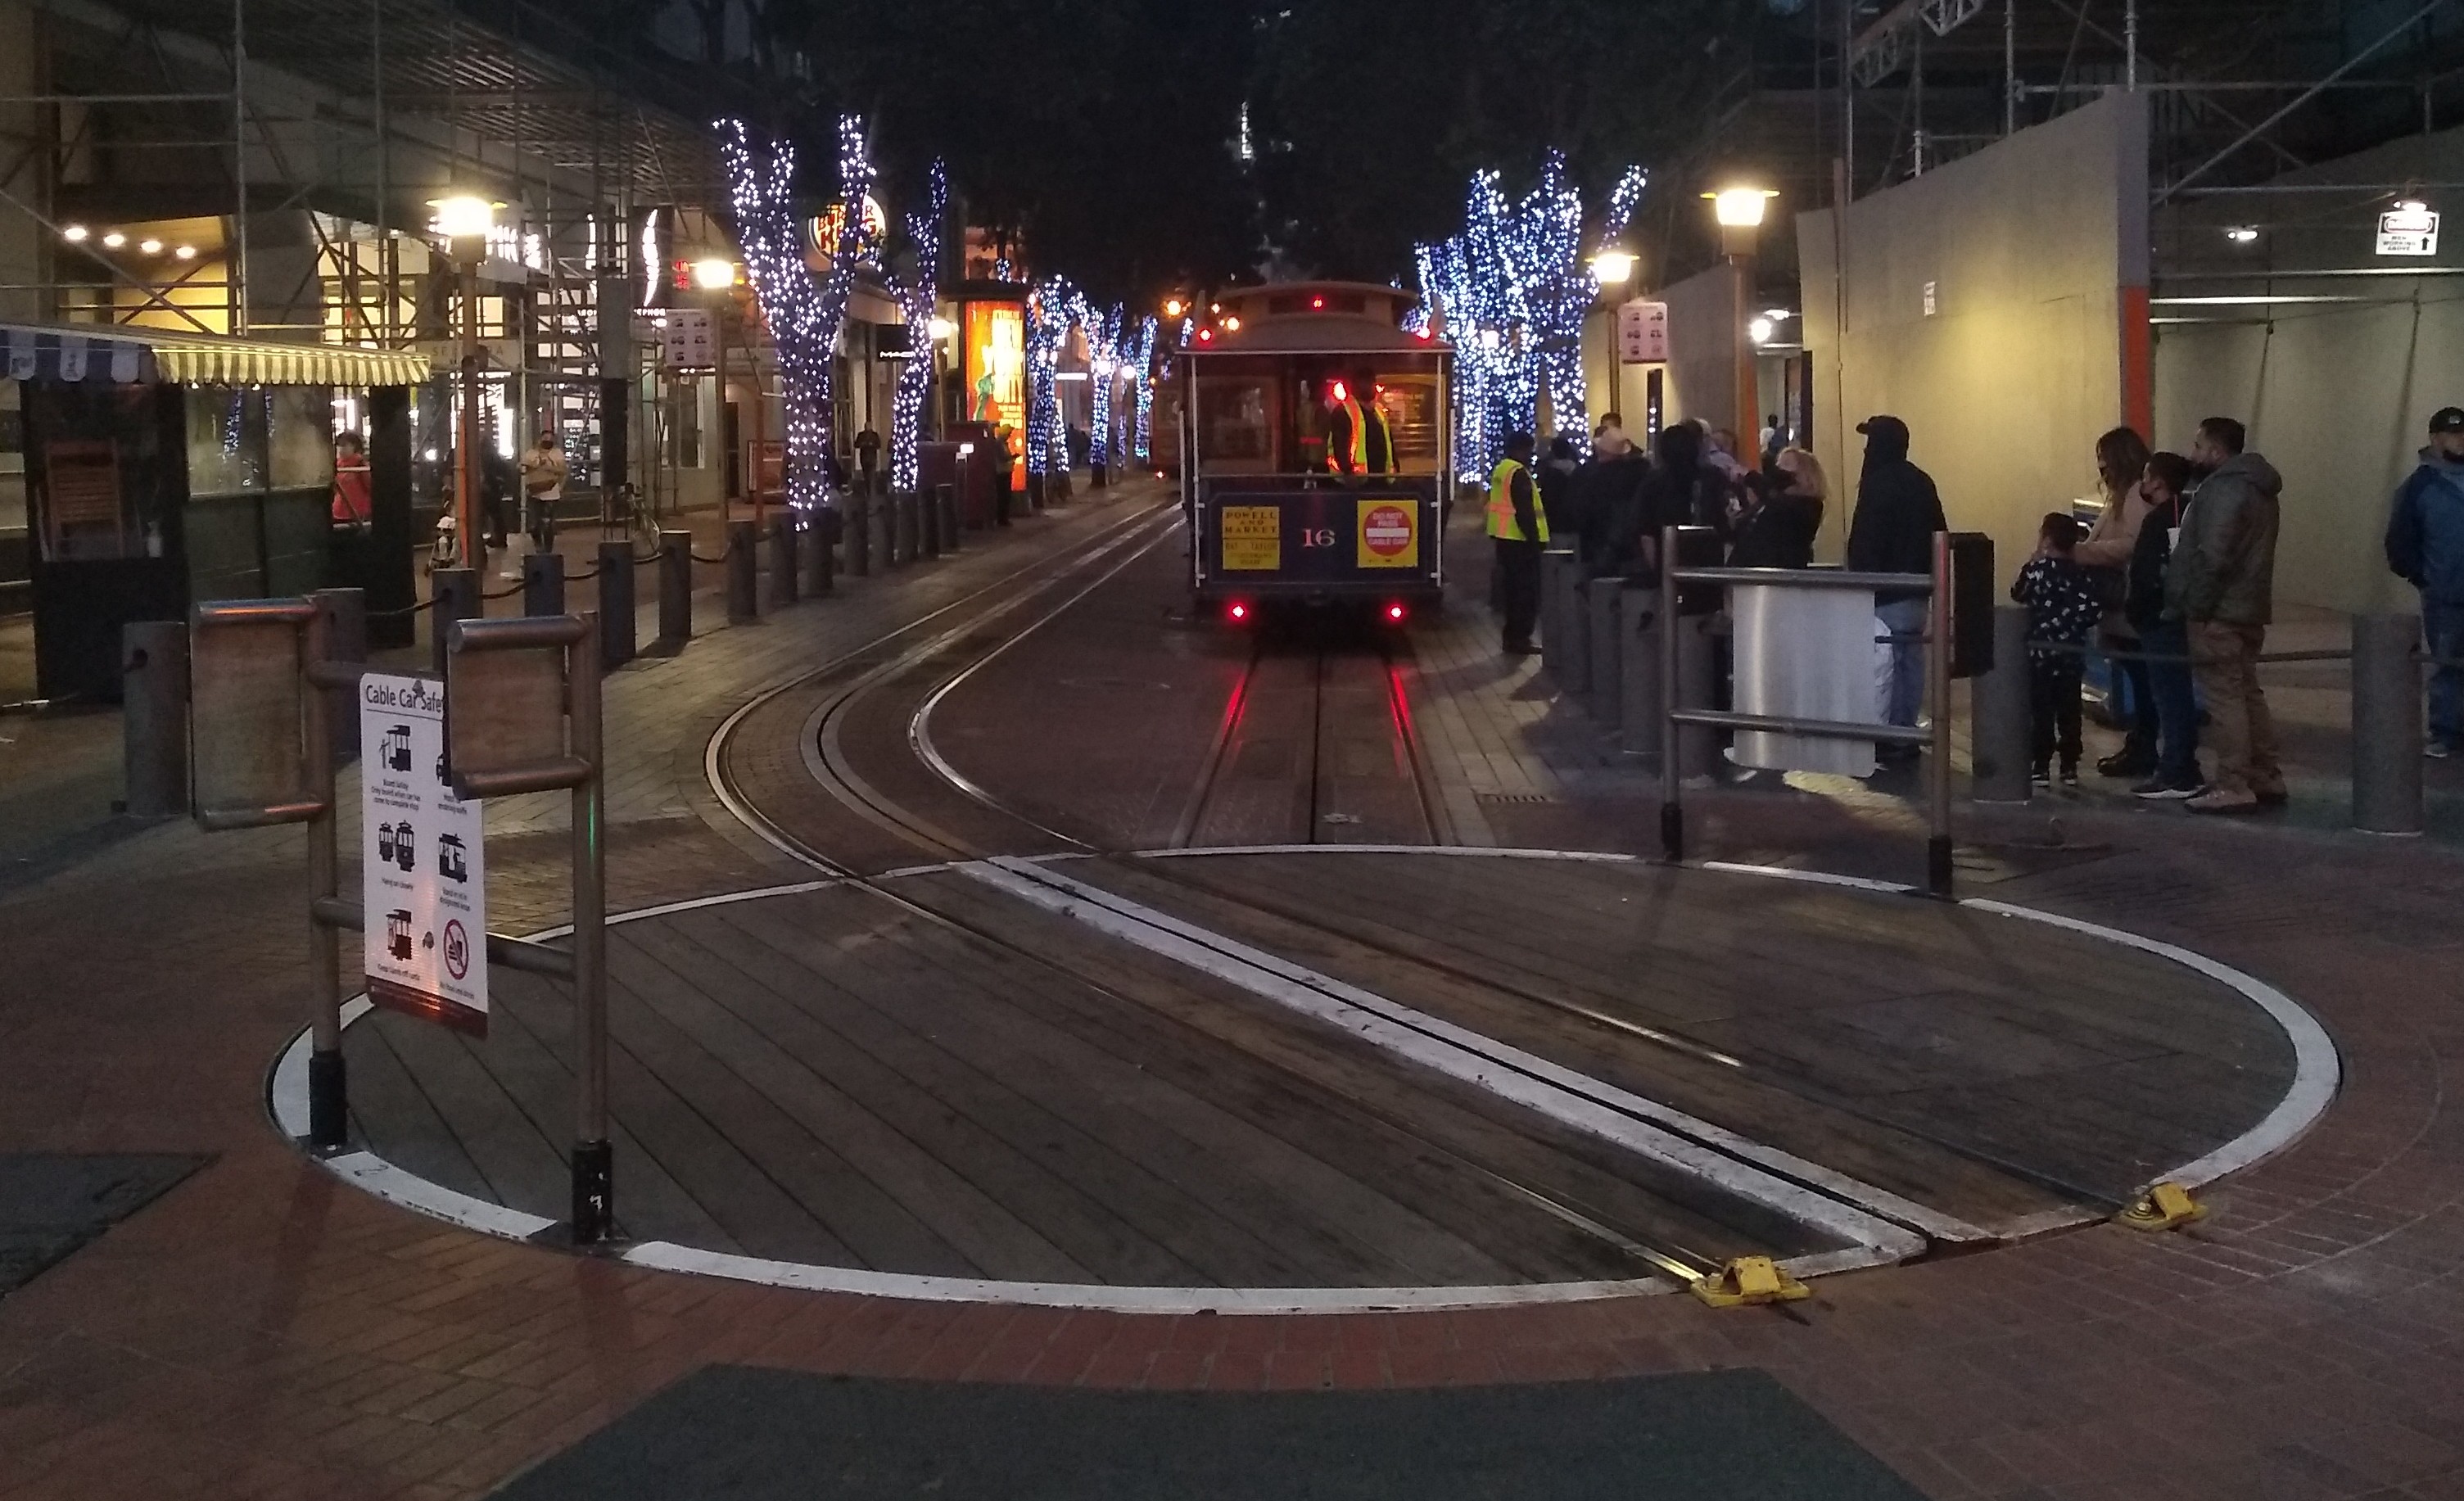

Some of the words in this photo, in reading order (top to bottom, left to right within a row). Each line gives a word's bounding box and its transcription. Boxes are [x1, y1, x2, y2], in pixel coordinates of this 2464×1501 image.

[1226, 511, 1277, 519] POWELL
[1225, 526, 1277, 534] MARKET
[1303, 528, 1336, 548] 16
[366, 685, 396, 707] Cable
[399, 689, 417, 708] Car
[421, 691, 443, 713] Safe
